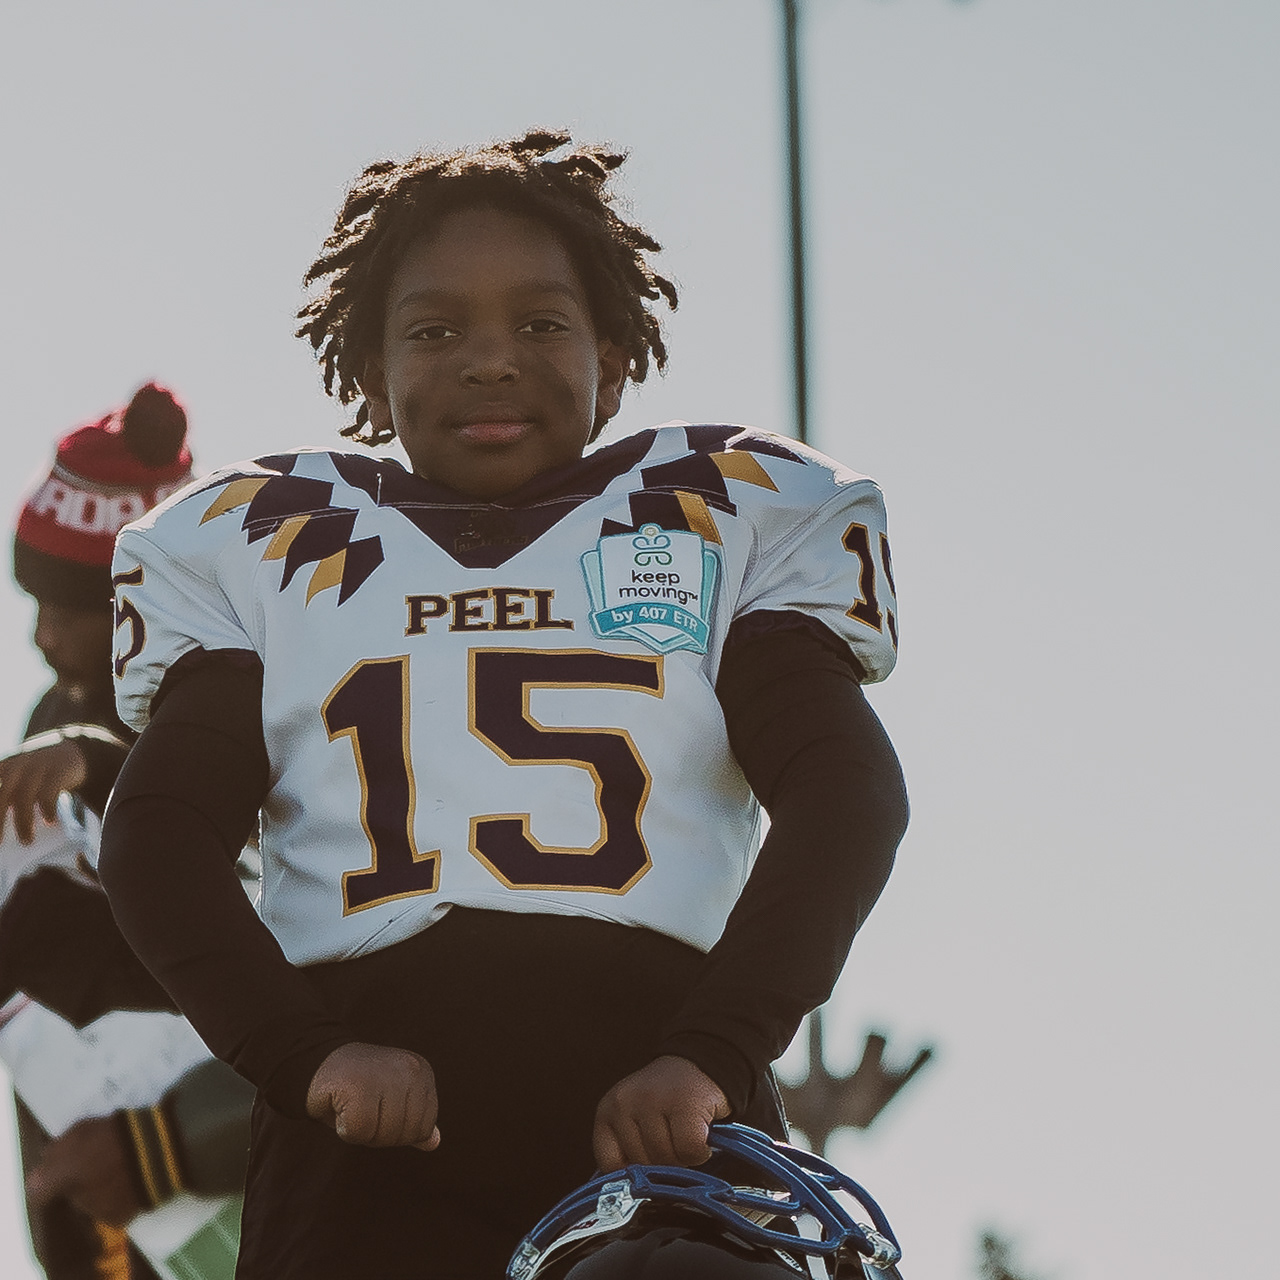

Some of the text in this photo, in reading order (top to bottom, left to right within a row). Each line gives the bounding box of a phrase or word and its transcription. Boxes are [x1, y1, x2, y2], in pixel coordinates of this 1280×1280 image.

[631, 570, 680, 585] keep
[841, 522, 898, 655] 1
[404, 586, 575, 637] PEEL
[611, 606, 698, 633] by 407 ETR
[321, 646, 665, 917] 15
